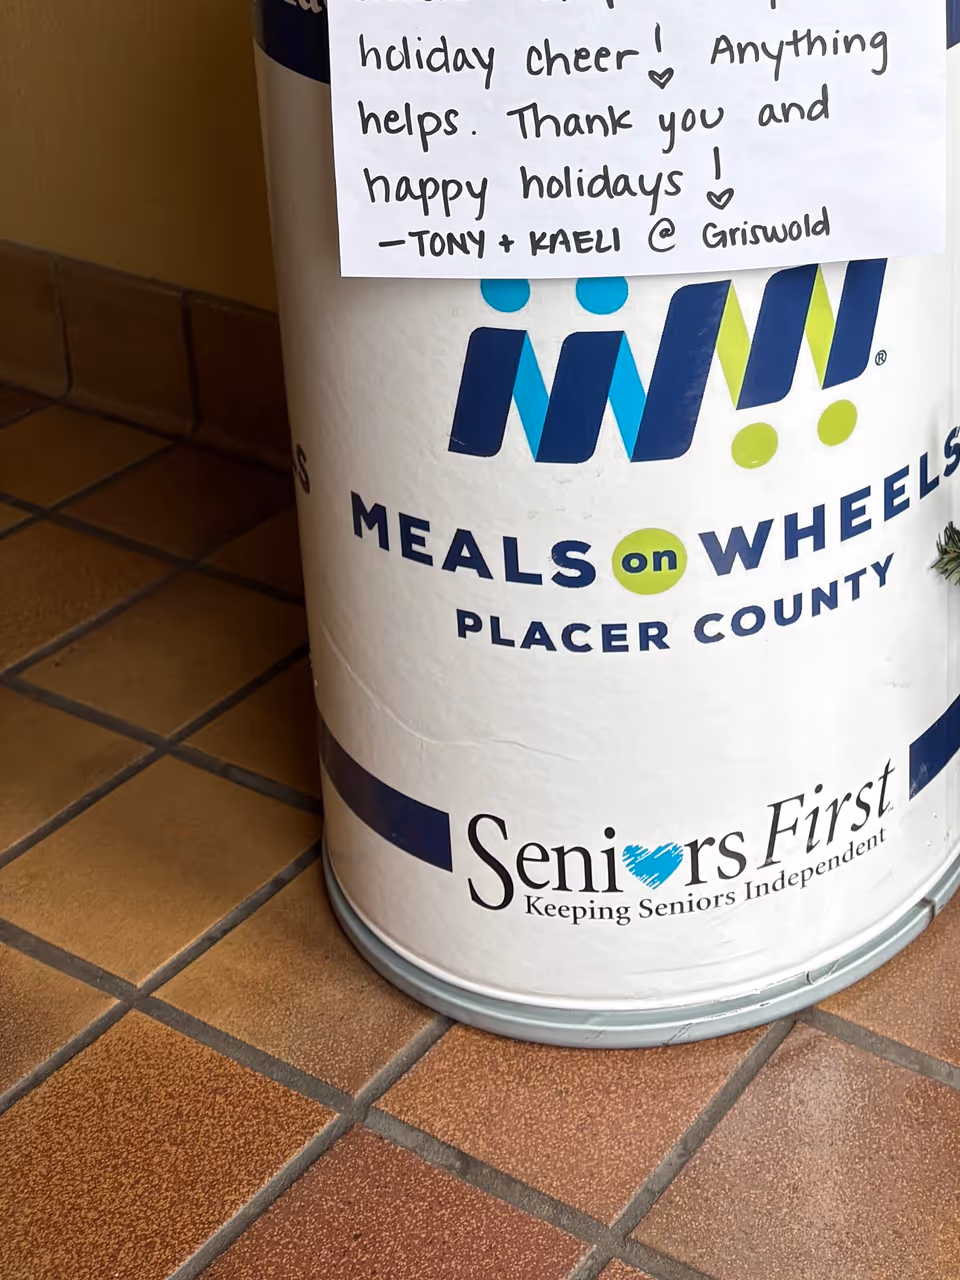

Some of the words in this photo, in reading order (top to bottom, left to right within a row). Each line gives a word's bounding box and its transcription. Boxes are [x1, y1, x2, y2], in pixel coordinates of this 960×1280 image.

[359, 33, 495, 90] holiday
[710, 28, 888, 82] Anything
[357, 100, 478, 153] helps.
[506, 102, 633, 140] Thank
[658, 106, 725, 154] you
[758, 83, 829, 127] and
[363, 167, 488, 221] happy
[529, 227, 621, 257] KAELI
[648, 217, 676, 253] @
[702, 206, 830, 249] Griswold
[350, 490, 597, 589] MEALS
[621, 549, 678, 574] on
[455, 608, 671, 653] PLACER
[693, 552, 894, 644] COUNTY
[756, 757, 896, 871] First
[525, 894, 631, 926] Keeping
[638, 889, 736, 919] Seniors
[743, 826, 887, 901] Independent
